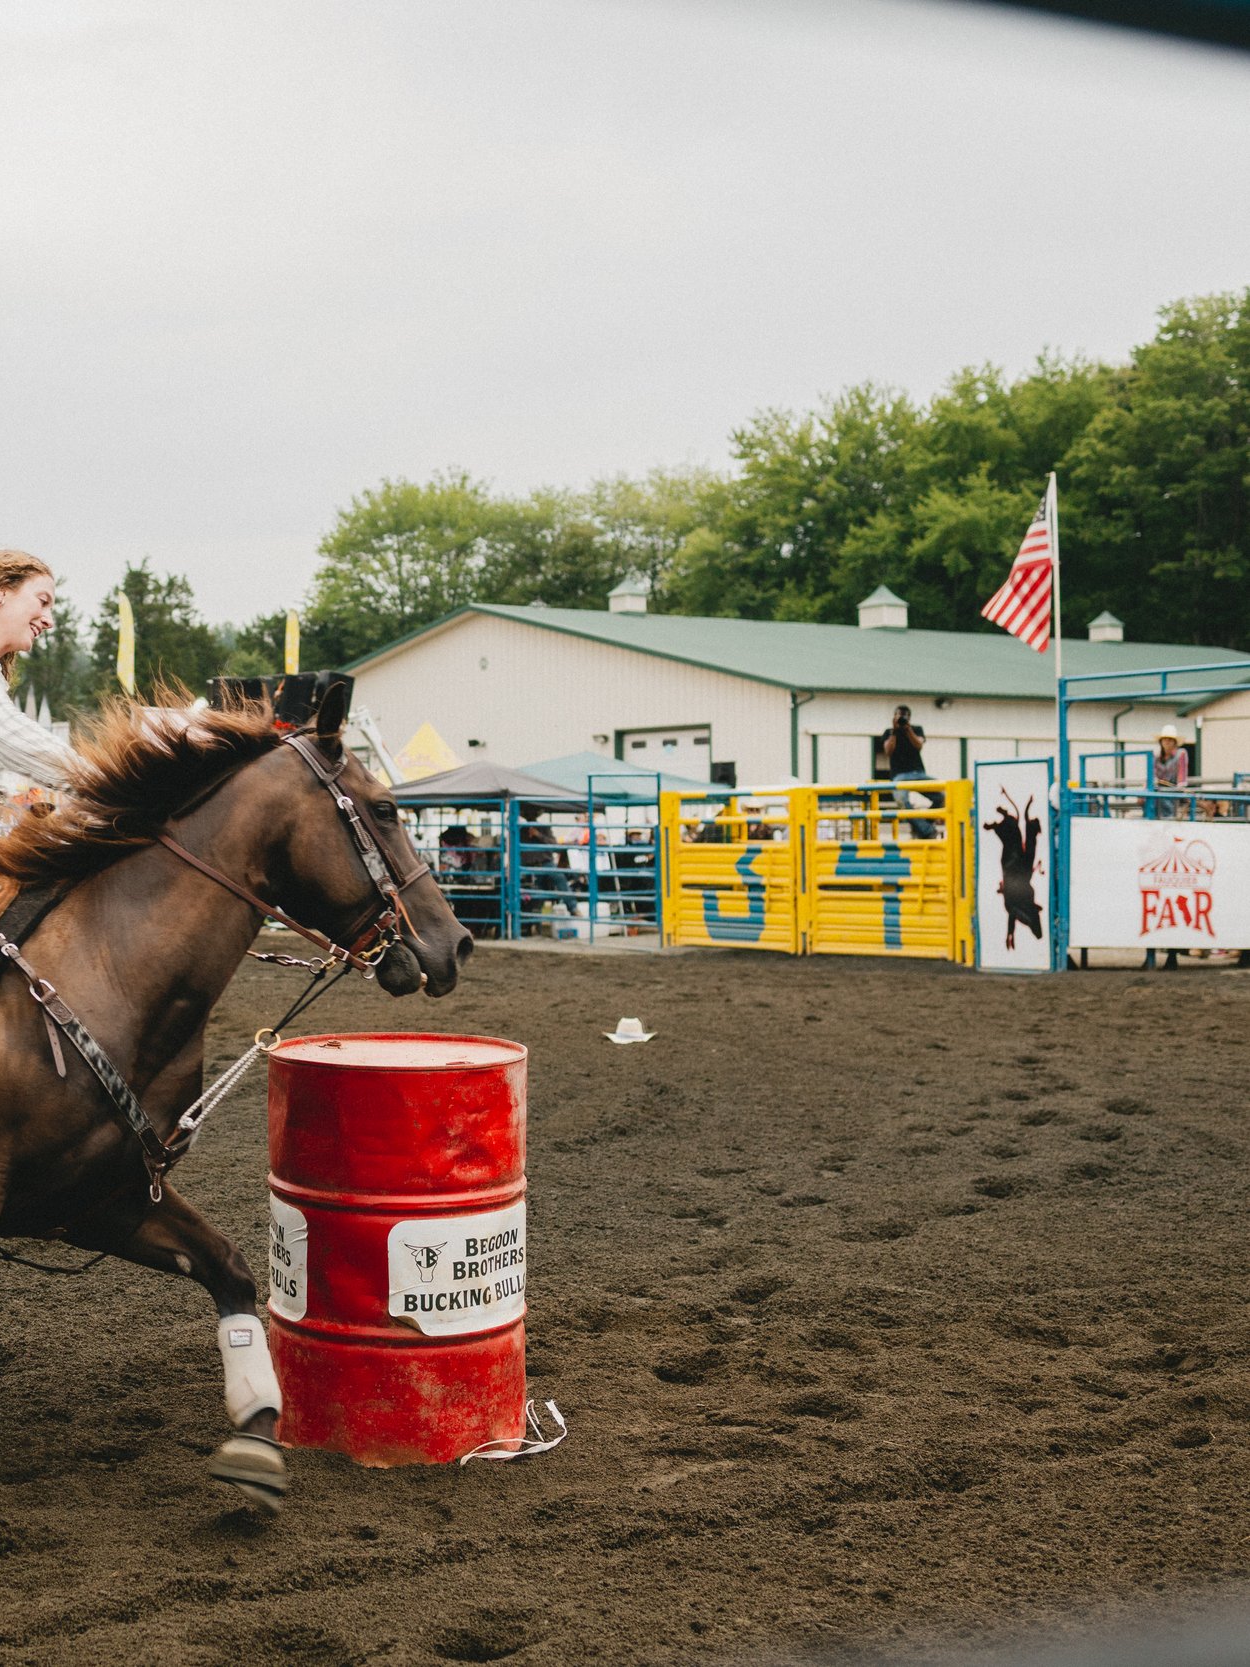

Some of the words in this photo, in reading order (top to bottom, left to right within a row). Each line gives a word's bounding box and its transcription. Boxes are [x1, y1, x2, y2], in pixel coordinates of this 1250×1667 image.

[465, 1228, 518, 1257] BEGOON
[453, 1247, 524, 1280] BROTHERS
[404, 1288, 492, 1312] BUCKING
